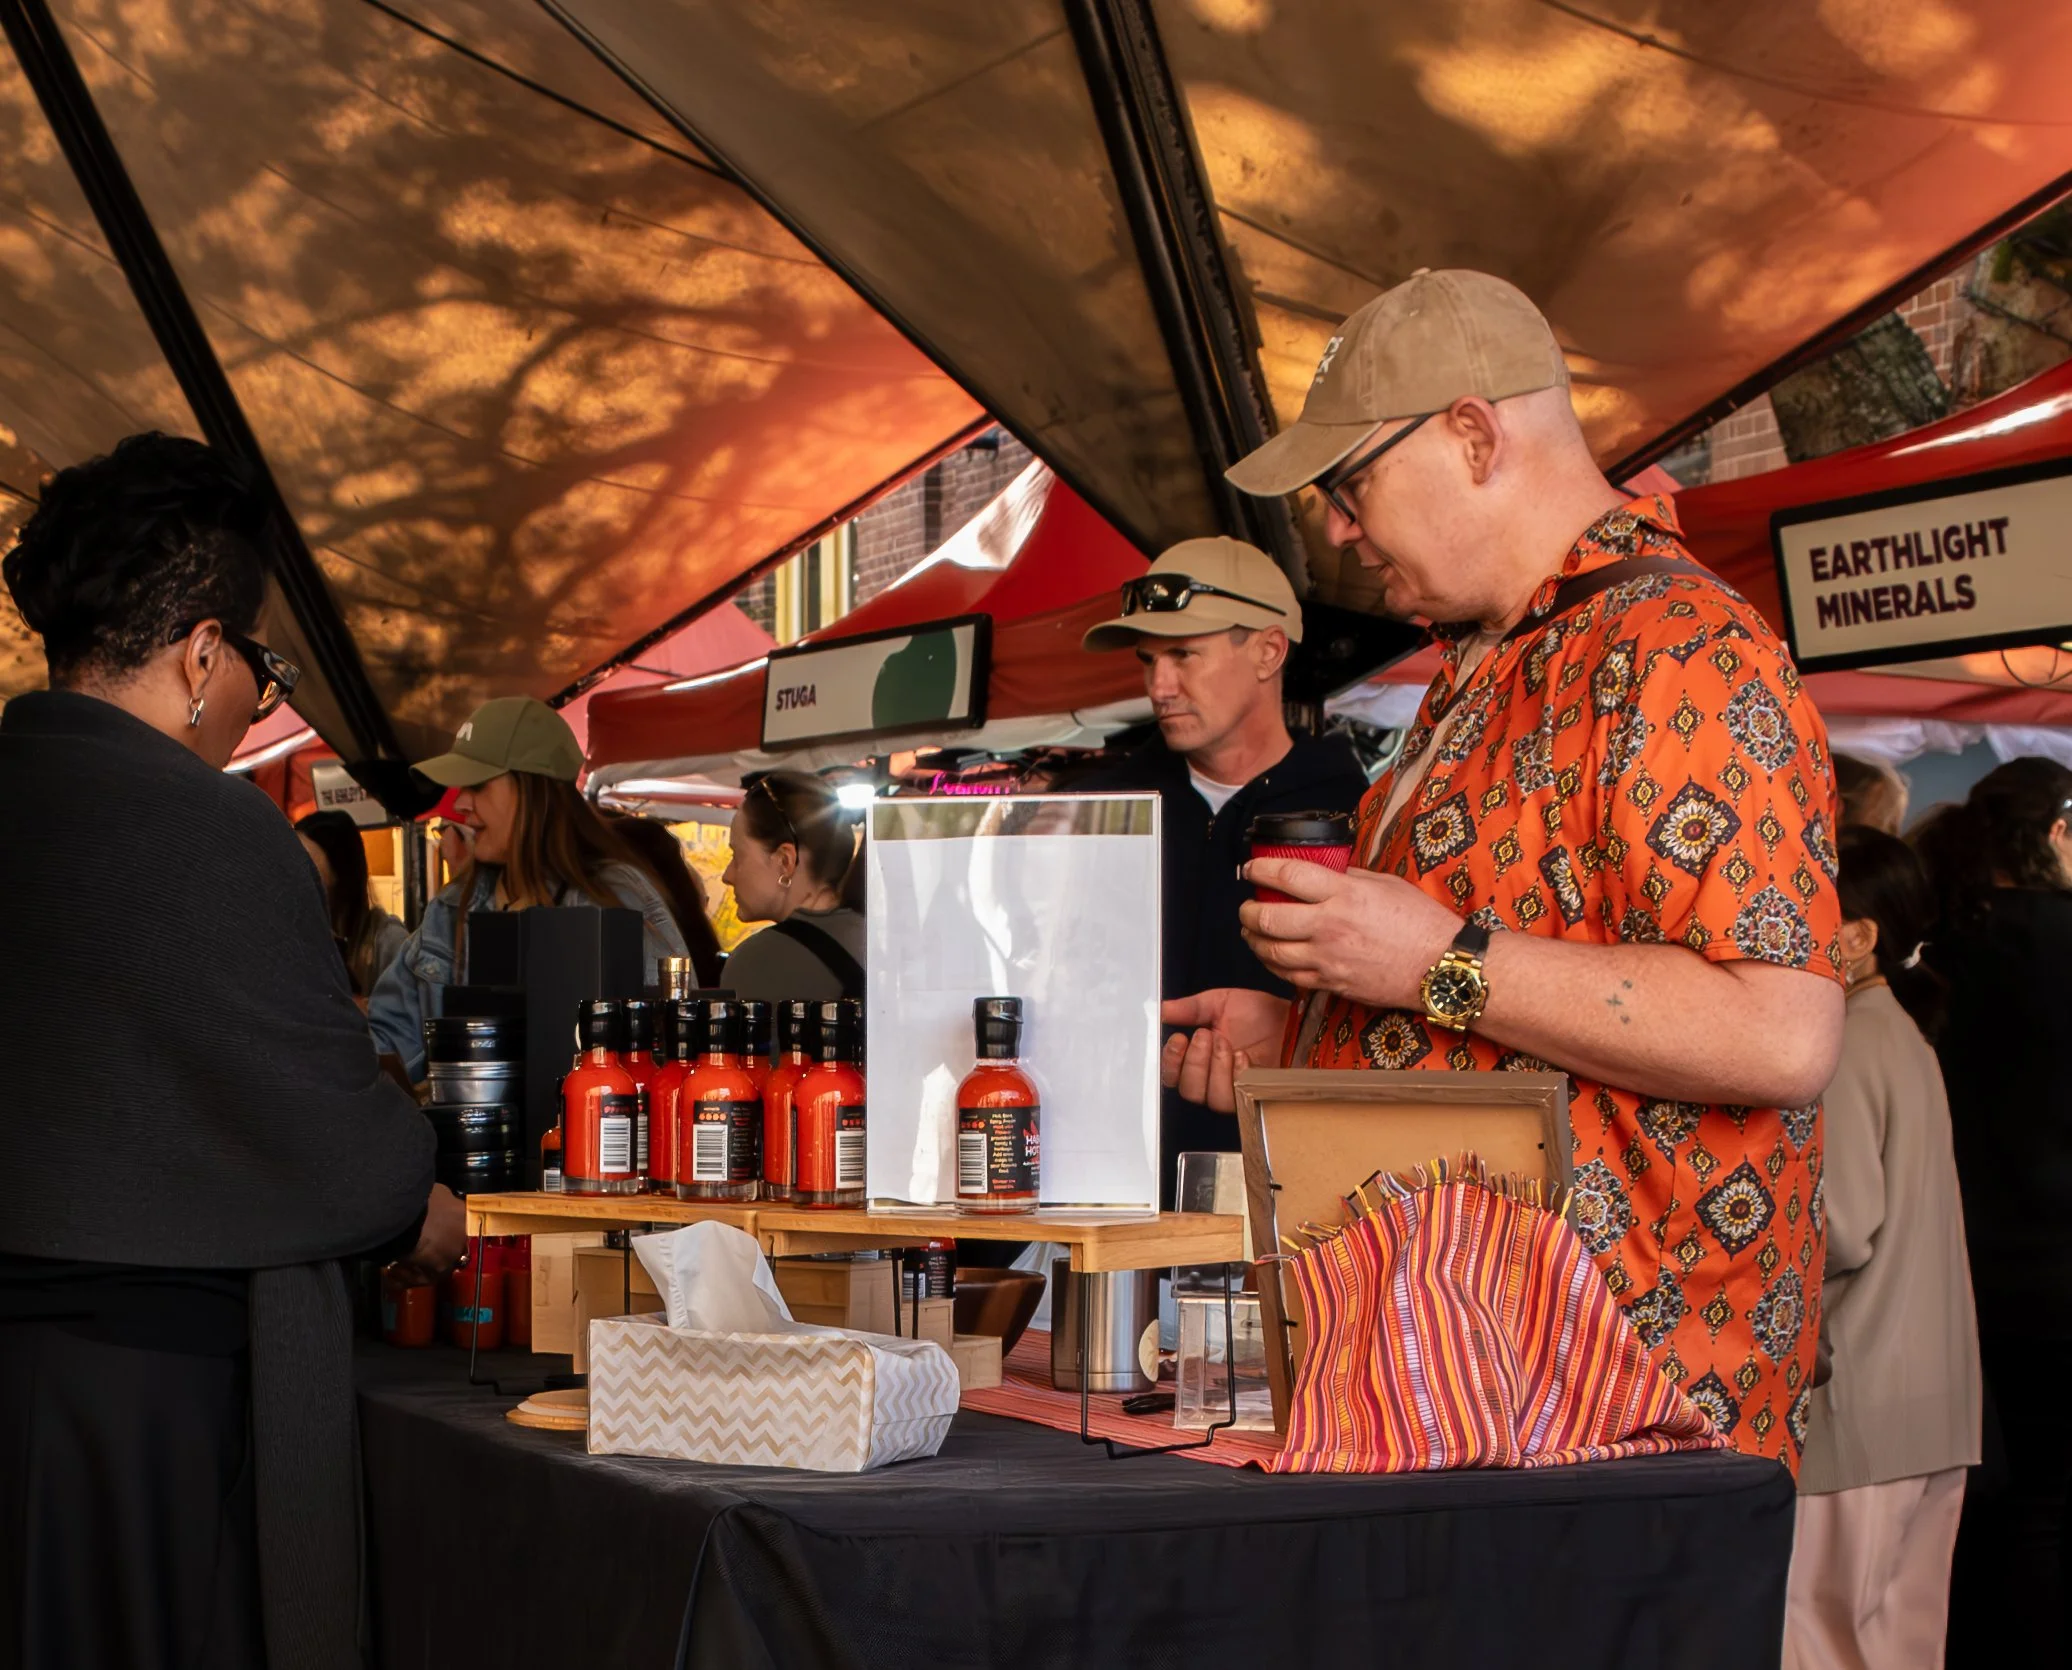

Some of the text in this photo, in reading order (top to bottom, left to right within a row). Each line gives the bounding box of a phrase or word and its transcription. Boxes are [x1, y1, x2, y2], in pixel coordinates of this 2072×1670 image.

[1809, 516, 2009, 583] EARTHLIGHT
[1815, 573, 1977, 630] MINERALS
[776, 684, 816, 712] STUGA
